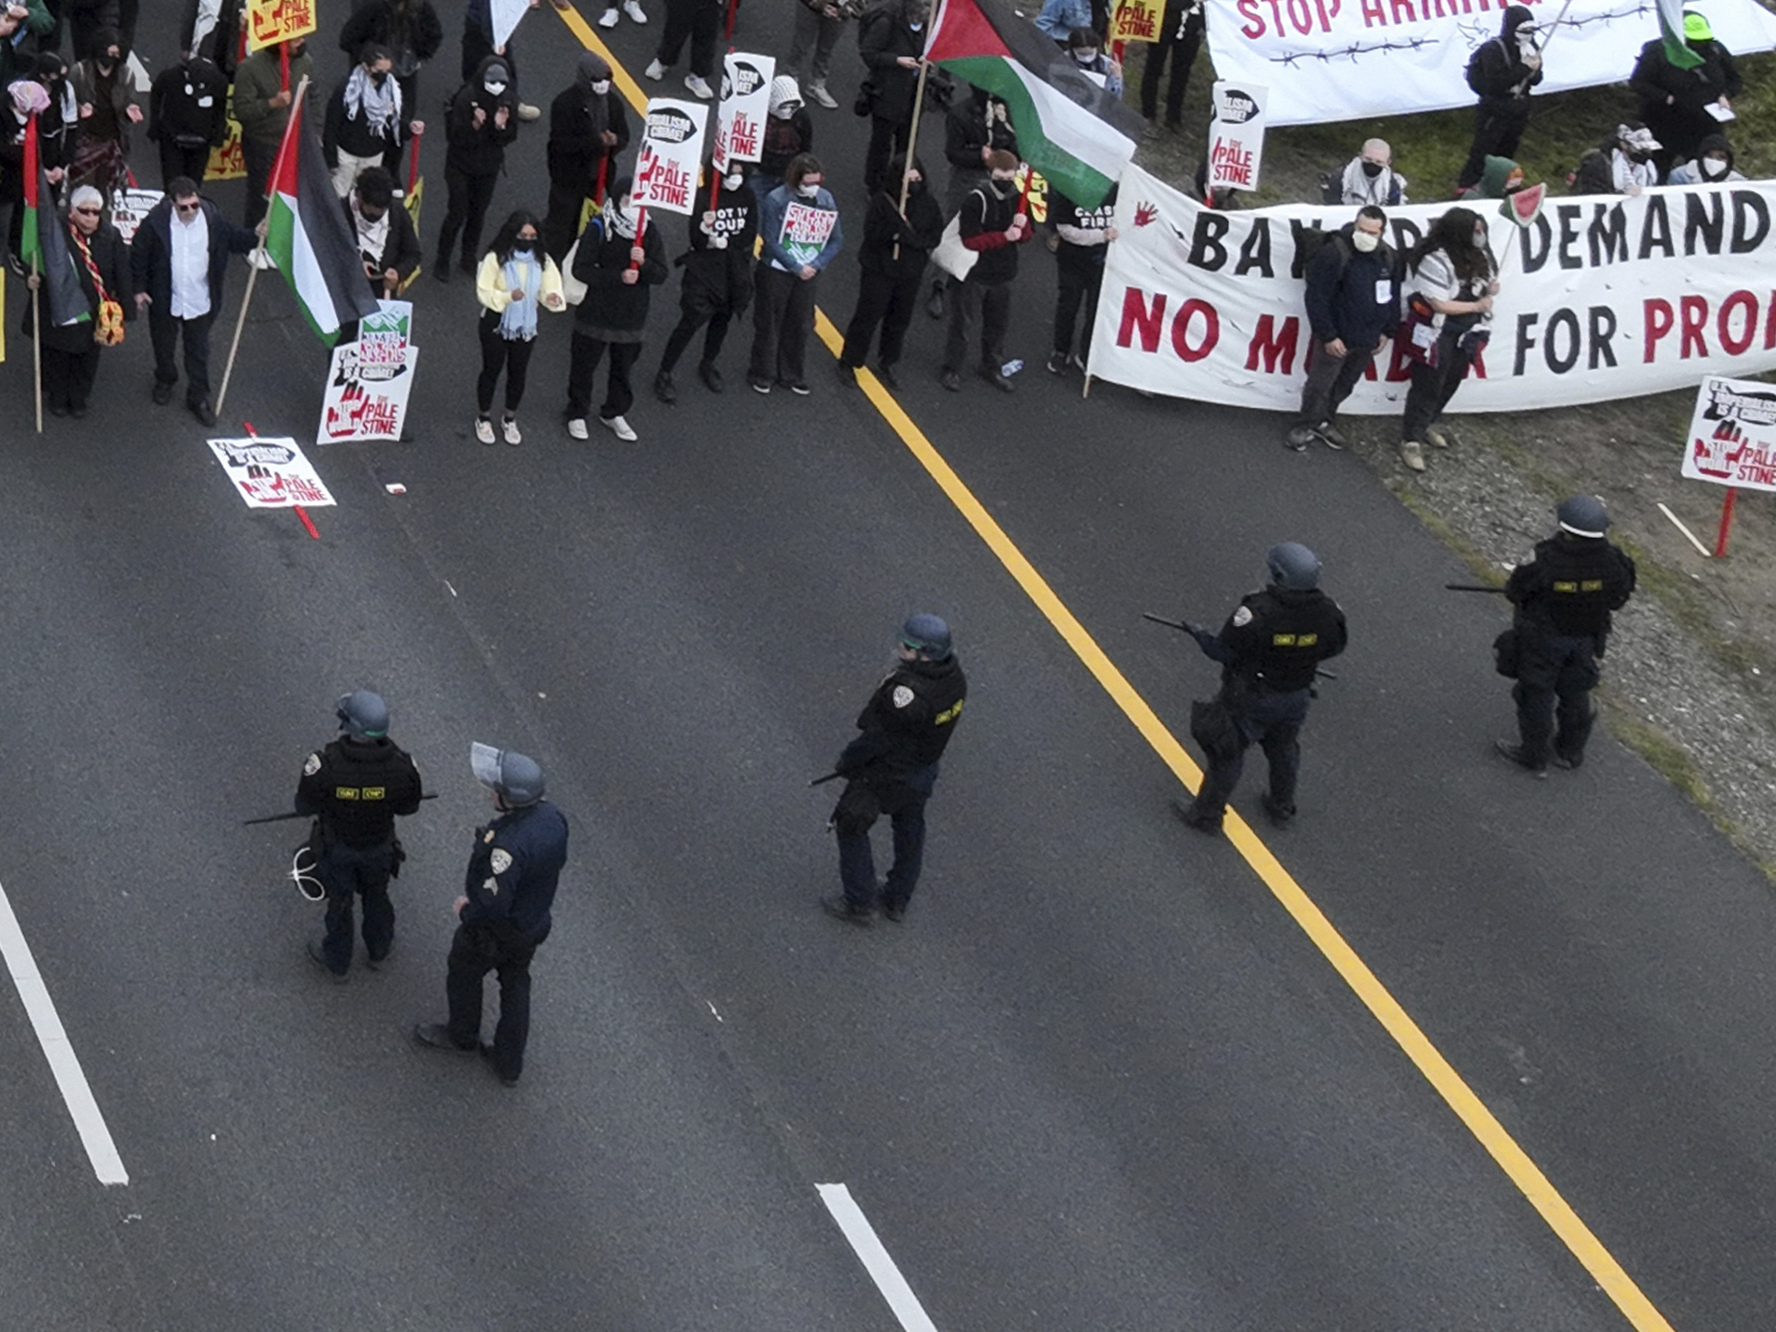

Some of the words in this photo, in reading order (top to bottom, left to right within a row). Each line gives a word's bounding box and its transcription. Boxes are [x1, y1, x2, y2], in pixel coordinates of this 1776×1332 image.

[283, 11, 312, 34] STINE
[1123, 4, 1157, 24] PALE
[1118, 20, 1156, 38] STINE
[1220, 147, 1253, 168] PALE
[655, 166, 691, 189] PALE
[1214, 165, 1252, 186] STINE
[650, 185, 688, 209] STINE
[714, 218, 746, 231] OUR
[1520, 189, 1771, 274] DEMAND
[1116, 287, 1221, 363] NO
[1513, 306, 1618, 376] FOR
[366, 402, 398, 421] PALE
[360, 420, 397, 436] STINE
